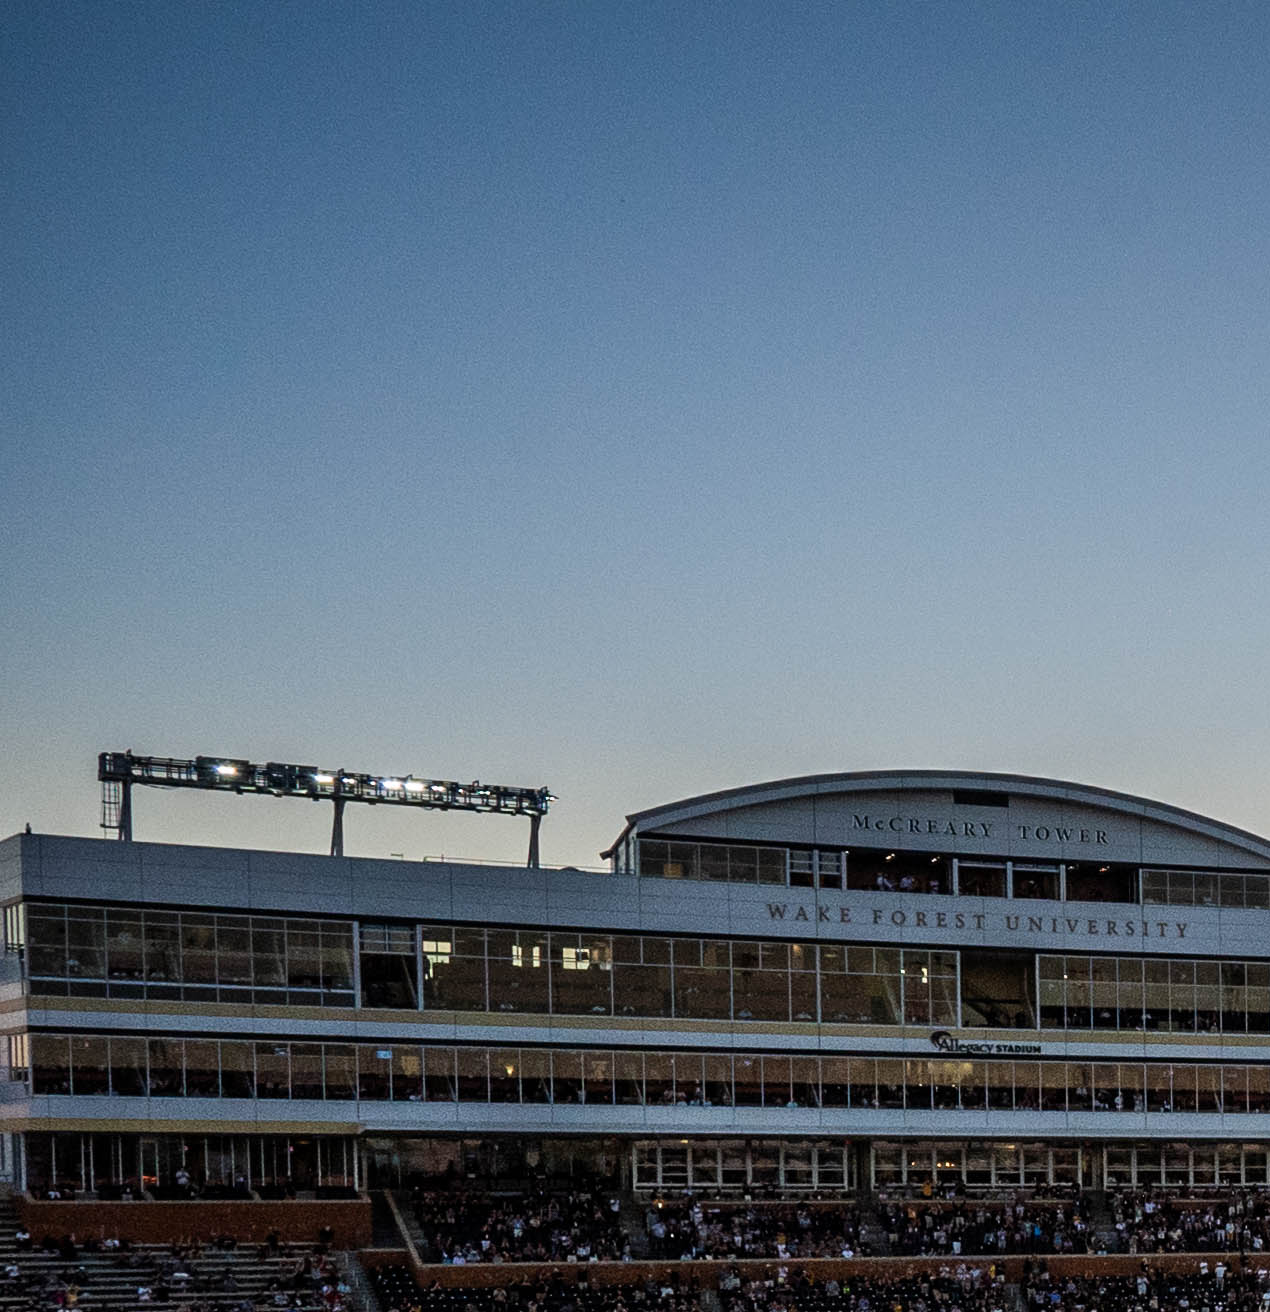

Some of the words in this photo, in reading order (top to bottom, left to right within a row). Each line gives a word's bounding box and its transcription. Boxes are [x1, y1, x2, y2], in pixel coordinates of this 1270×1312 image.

[1017, 825, 1110, 844] TOWER
[767, 903, 850, 923] WAKE
[872, 909, 987, 930] FOREST
[1005, 915, 1189, 938] UNIVERSITY
[996, 1044, 1041, 1054] STADIUM
